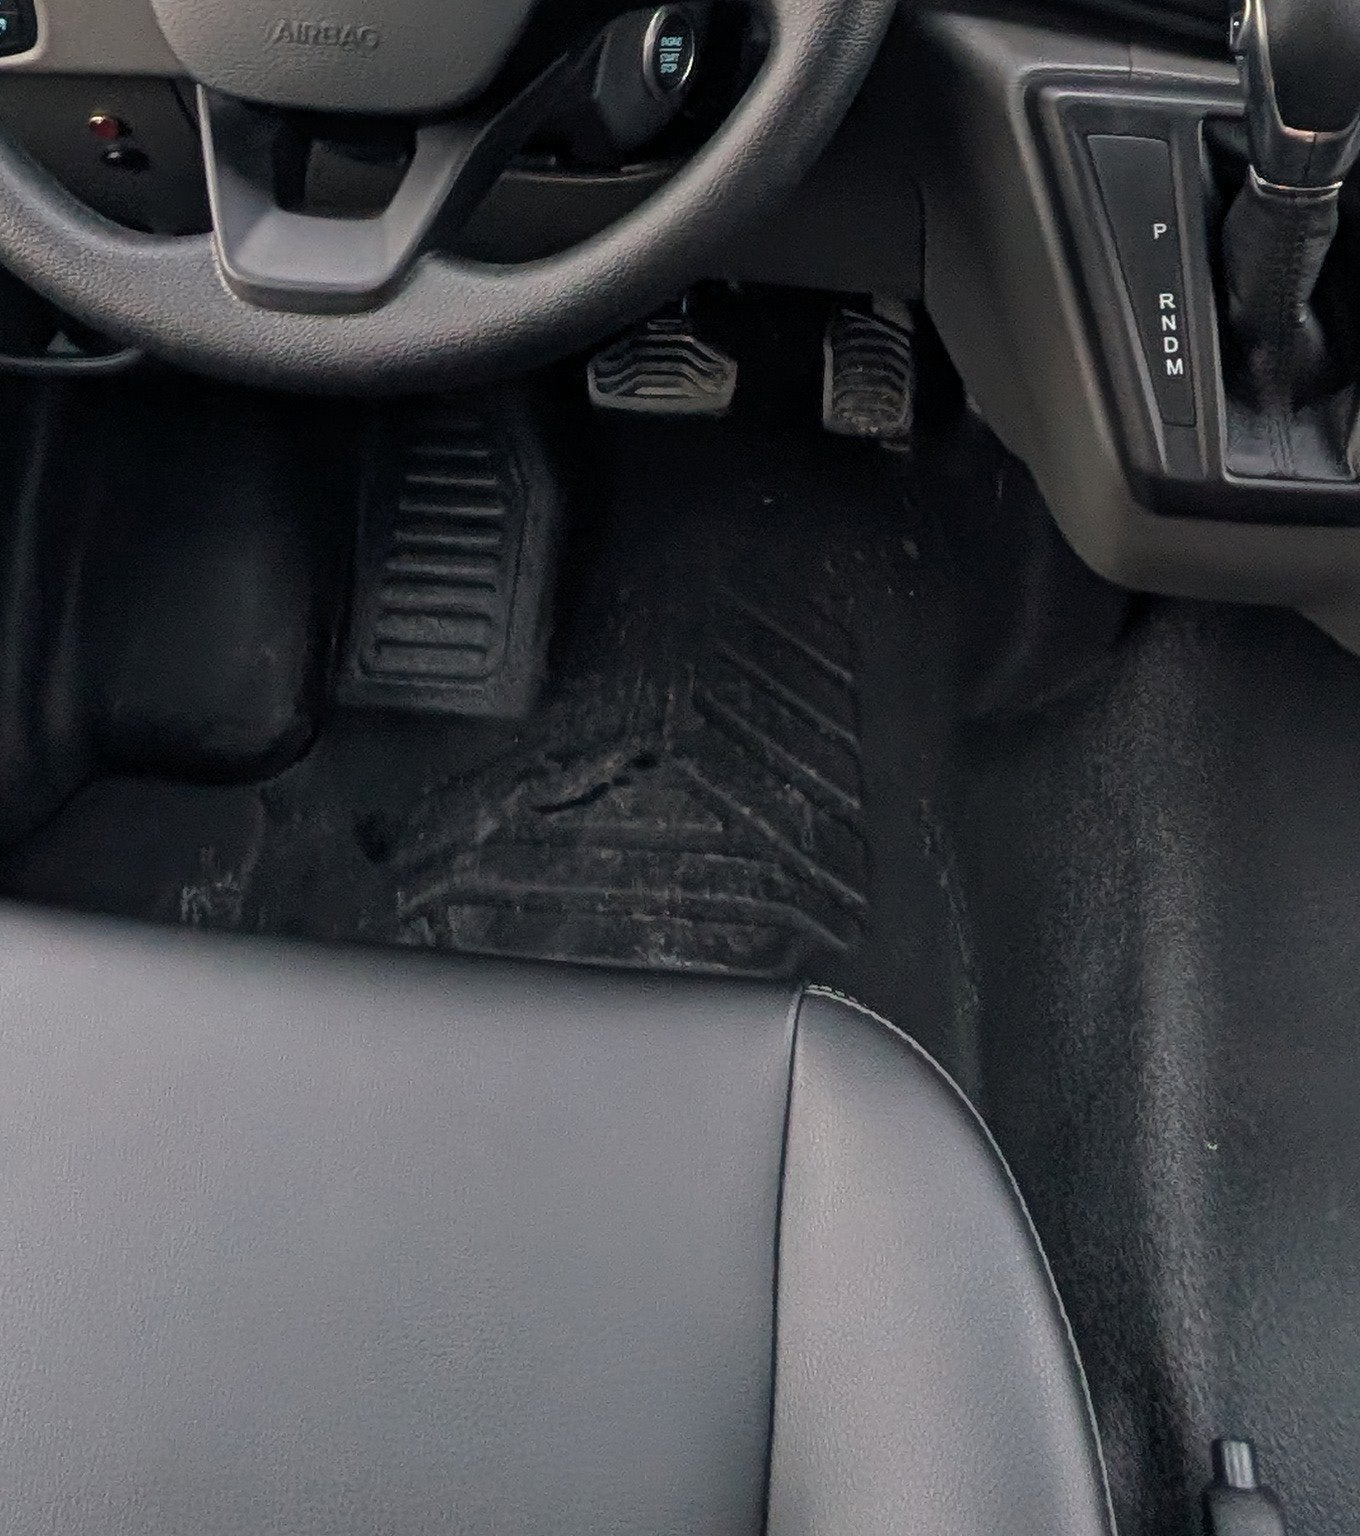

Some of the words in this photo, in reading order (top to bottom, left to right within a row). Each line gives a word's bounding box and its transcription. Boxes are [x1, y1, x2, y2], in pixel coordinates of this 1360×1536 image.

[262, 18, 383, 50] AIRBAG
[1152, 222, 1168, 240] P
[1158, 292, 1177, 310] R
[1160, 314, 1177, 332] N
[1162, 336, 1180, 354] D
[1165, 357, 1185, 376] M
